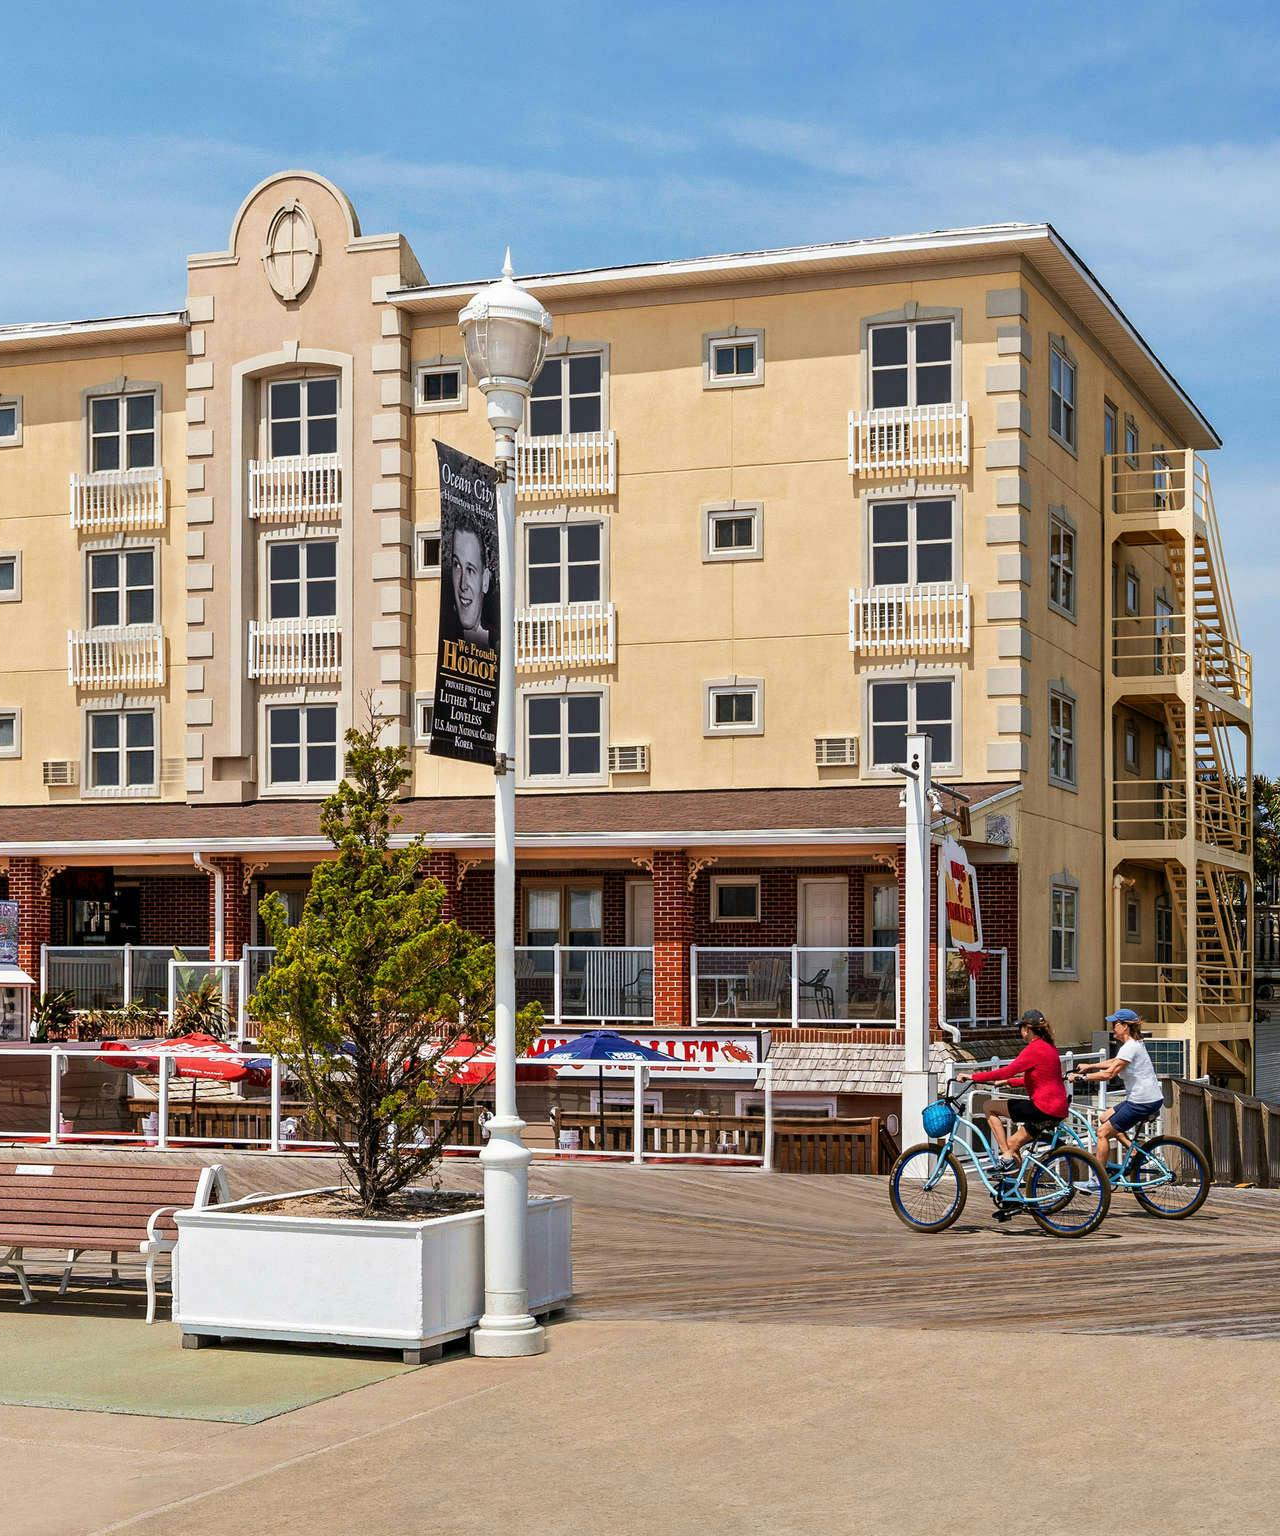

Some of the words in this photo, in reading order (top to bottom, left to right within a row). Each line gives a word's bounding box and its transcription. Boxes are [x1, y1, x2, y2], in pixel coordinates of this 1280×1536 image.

[442, 463, 471, 494] Ocean
[474, 478, 495, 511] City
[458, 638, 470, 655] We
[441, 639, 496, 682] Honor
[440, 688, 468, 709] LUTHER
[464, 684, 477, 696] FIRST
[477, 688, 492, 699] CLASS
[434, 718, 445, 732] U.S.
[450, 705, 483, 727] LOVELESS
[454, 736, 475, 751] KOREA
